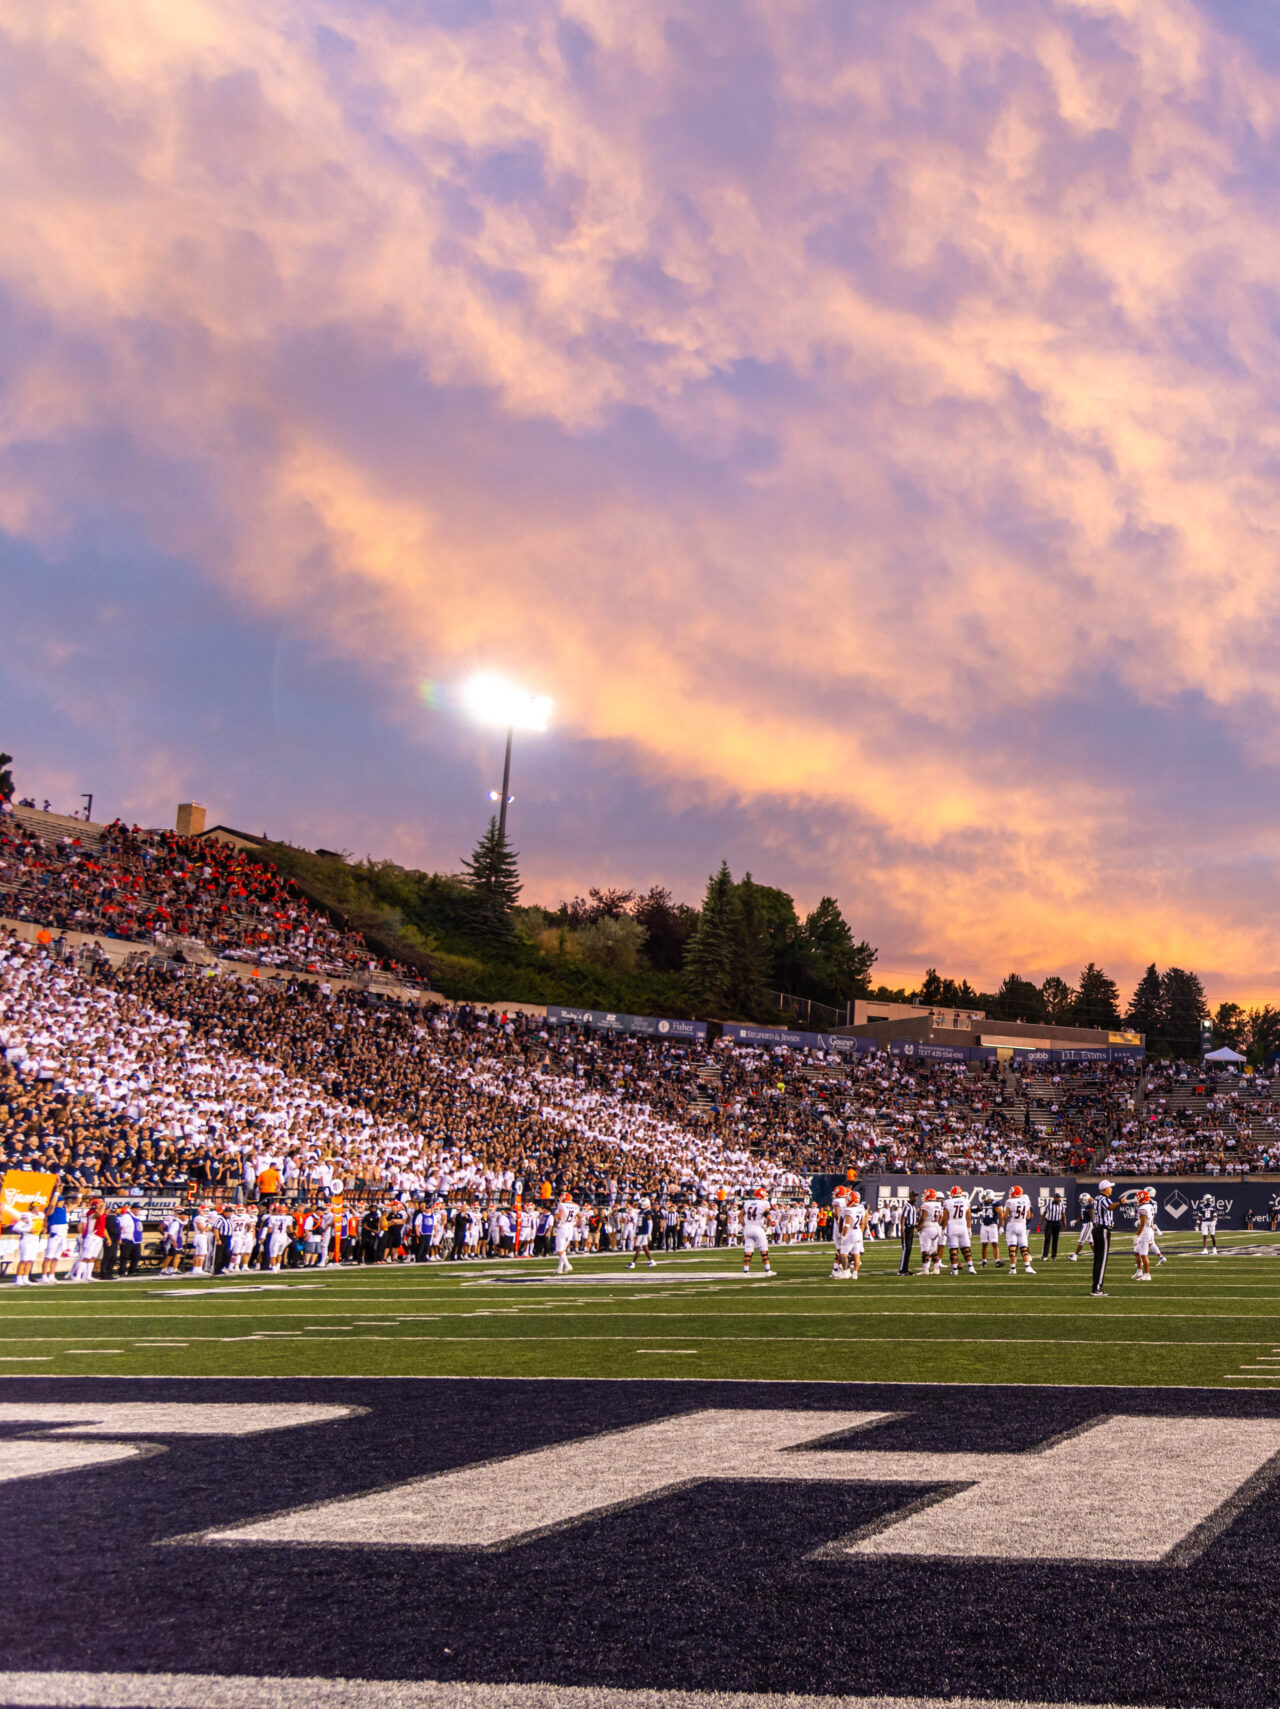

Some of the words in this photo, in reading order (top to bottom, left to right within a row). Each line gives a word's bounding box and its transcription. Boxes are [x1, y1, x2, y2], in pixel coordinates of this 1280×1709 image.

[672, 1021, 694, 1032] Fisher
[1081, 1050, 1107, 1060] Evans
[188, 1182, 198, 1201] 2
[747, 1207, 758, 1221] 64
[953, 1204, 964, 1219] 76
[1015, 1205, 1027, 1219] 54
